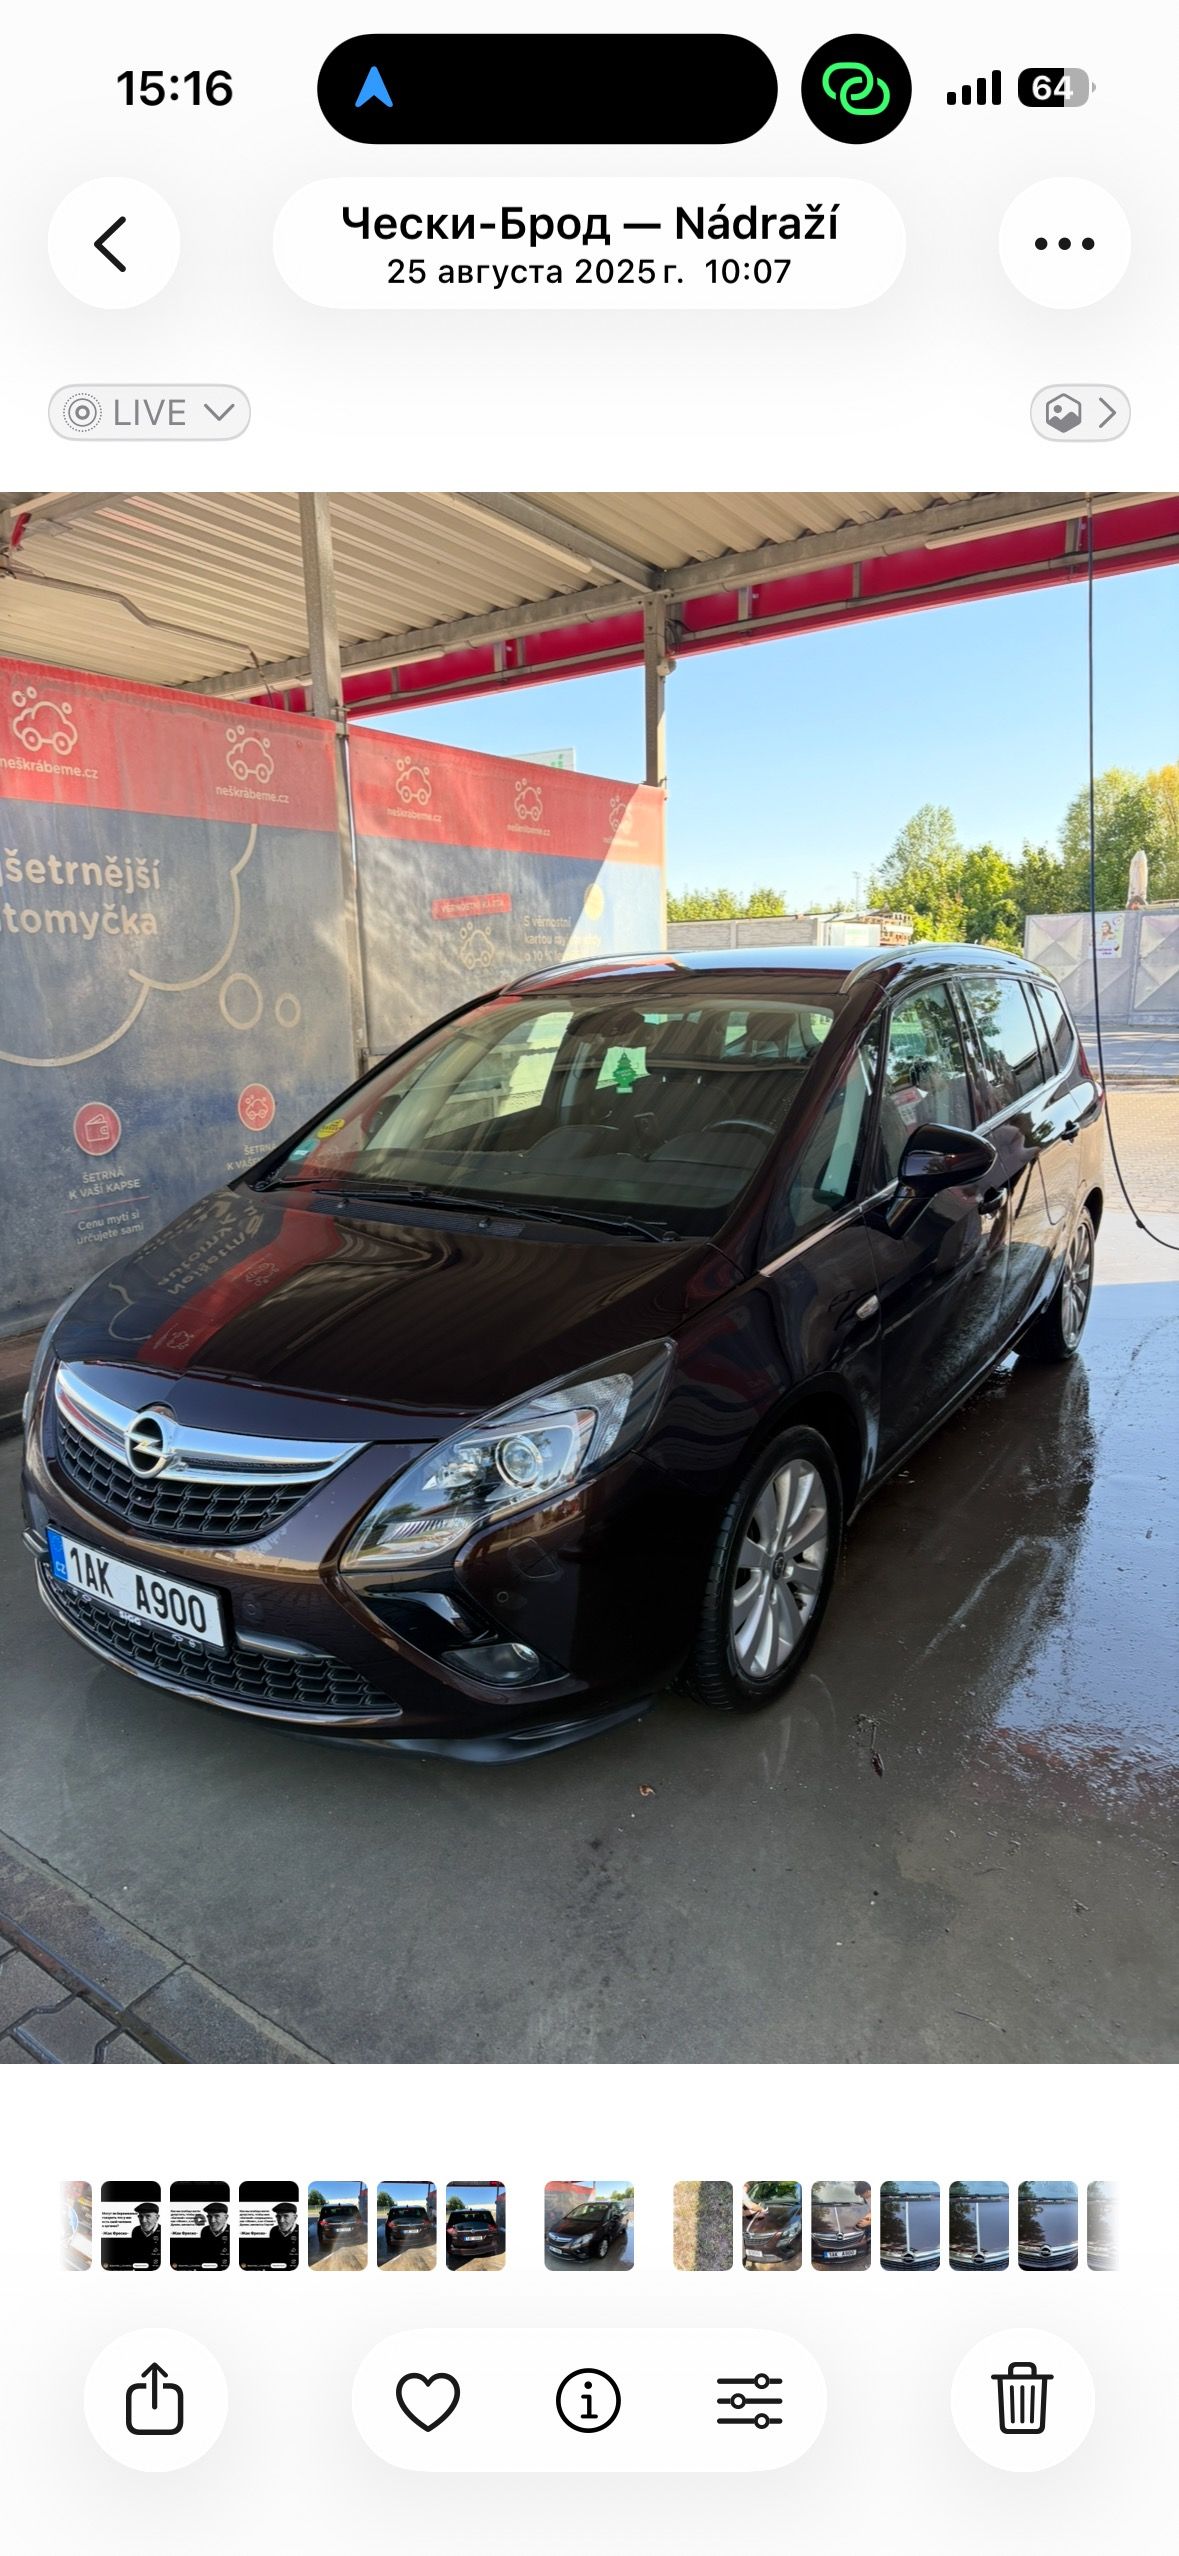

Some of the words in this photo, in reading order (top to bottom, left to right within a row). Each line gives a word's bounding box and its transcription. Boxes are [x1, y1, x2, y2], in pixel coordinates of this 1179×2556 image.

[0, 757, 98, 780] neškrábeme.cz
[215, 785, 290, 804] neškrábeme.cz
[0, 902, 158, 940] tomyčka
[82, 1166, 125, 1184] ŠETRNÁ
[68, 1189, 78, 1200] K
[80, 1182, 104, 1198] VAŠÍ
[106, 1178, 141, 1193] KAPSE
[76, 1228, 119, 1245] určujete
[121, 1221, 145, 1235] sami
[78, 1220, 105, 1231] Cenu
[70, 1546, 114, 1599] 1AK
[135, 1574, 207, 1633] A900
